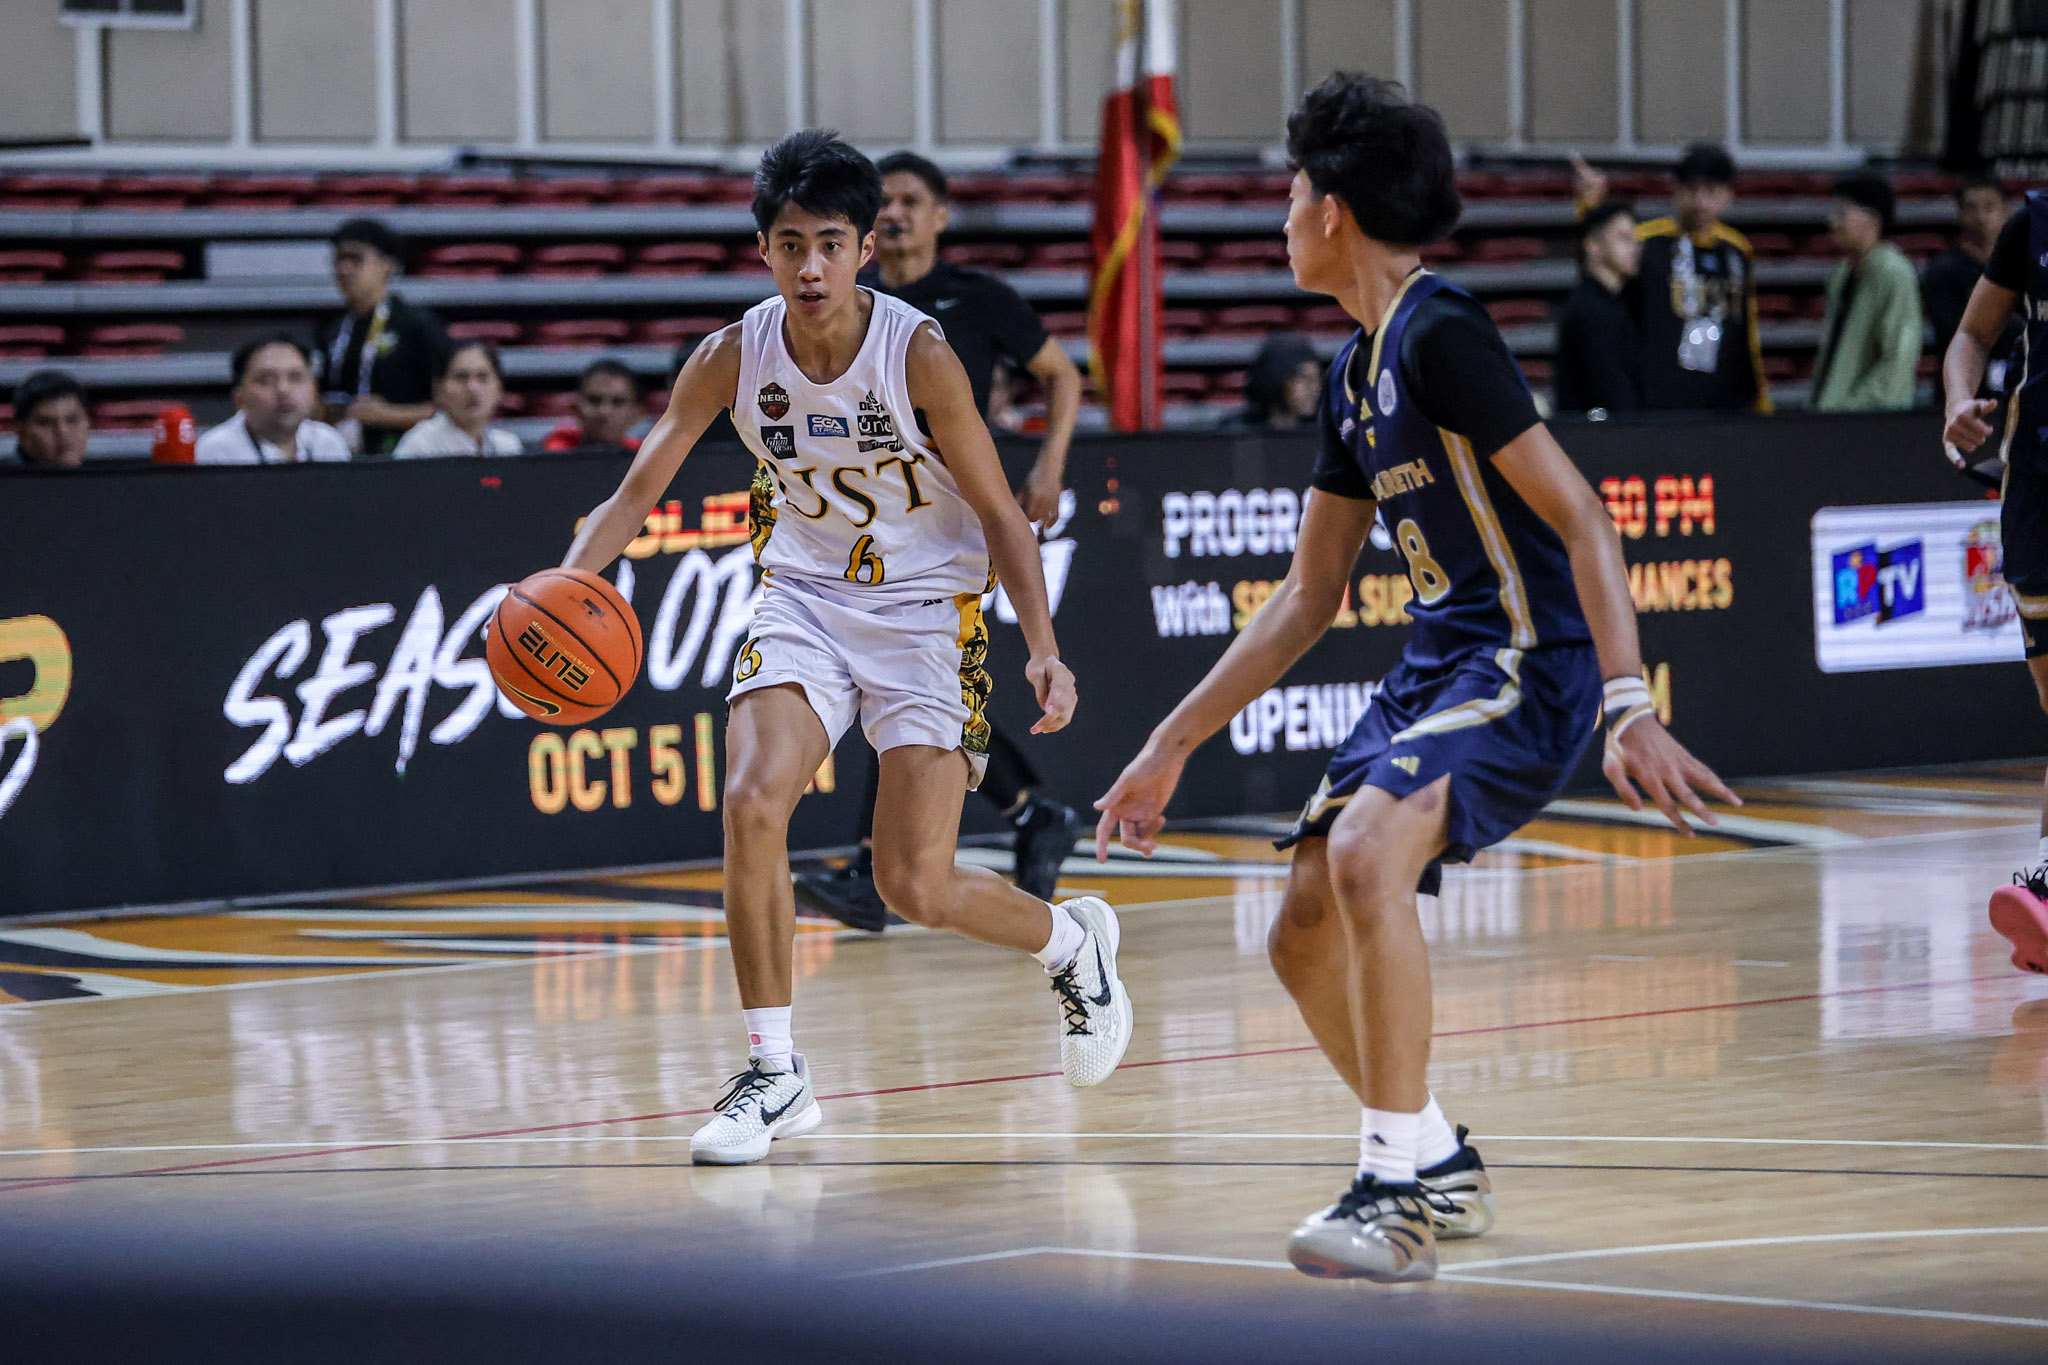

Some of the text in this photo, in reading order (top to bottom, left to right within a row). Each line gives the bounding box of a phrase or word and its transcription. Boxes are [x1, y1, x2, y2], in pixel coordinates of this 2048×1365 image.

[763, 452, 932, 528] UST
[1161, 487, 1312, 558] PROGR
[1654, 473, 1716, 537] PM
[1370, 457, 1435, 500] ARETH
[843, 534, 885, 584] 6
[1151, 580, 1231, 637] With
[1626, 557, 1734, 613] MANCES
[1396, 518, 1452, 606] 8
[223, 560, 636, 785] SEAS
[517, 624, 591, 692] ELITE
[736, 637, 763, 684] 6
[1229, 681, 1382, 755] OPENIN
[528, 726, 639, 815] OCT
[649, 723, 687, 806] 5
